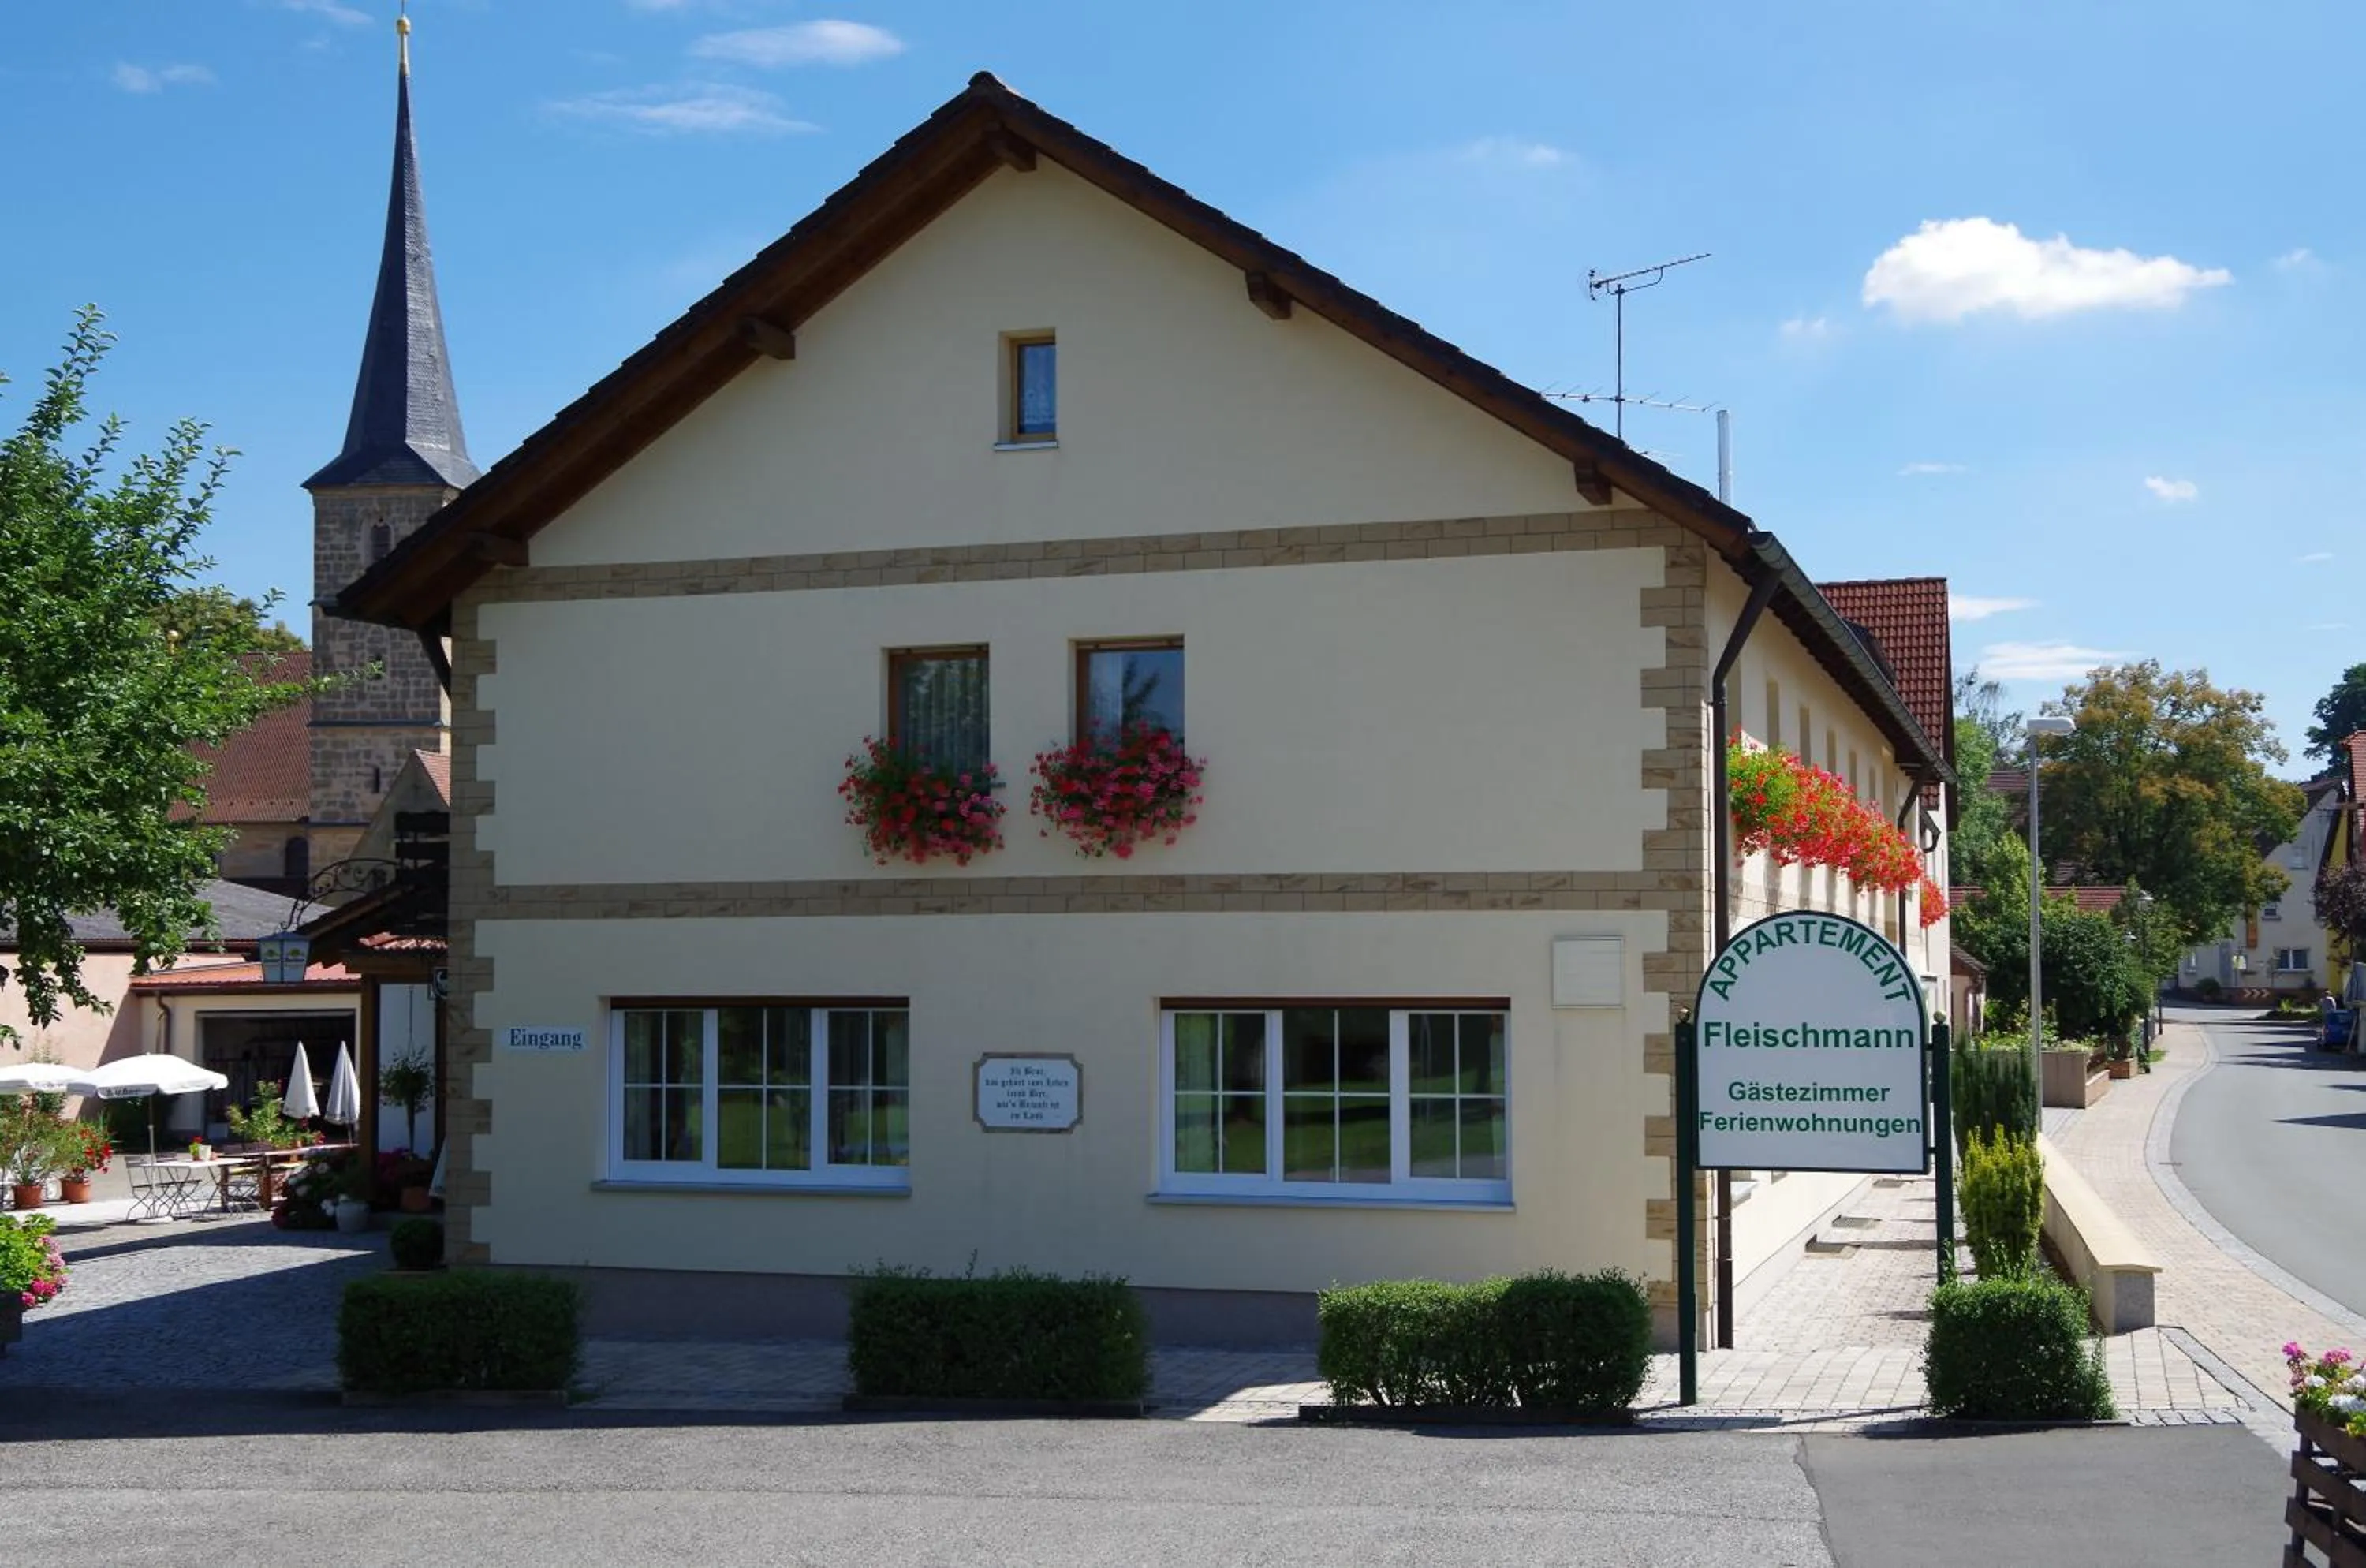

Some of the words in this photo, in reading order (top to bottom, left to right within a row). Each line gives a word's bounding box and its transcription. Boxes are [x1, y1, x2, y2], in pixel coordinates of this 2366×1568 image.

[1708, 919, 1912, 1002] APPARTEMENT
[509, 1027, 583, 1050] Eingang
[1704, 1021, 1915, 1049] Fleischmann
[1727, 1081, 1891, 1103] Gästezimmer
[1699, 1111, 1921, 1138] Ferienwohnungen
